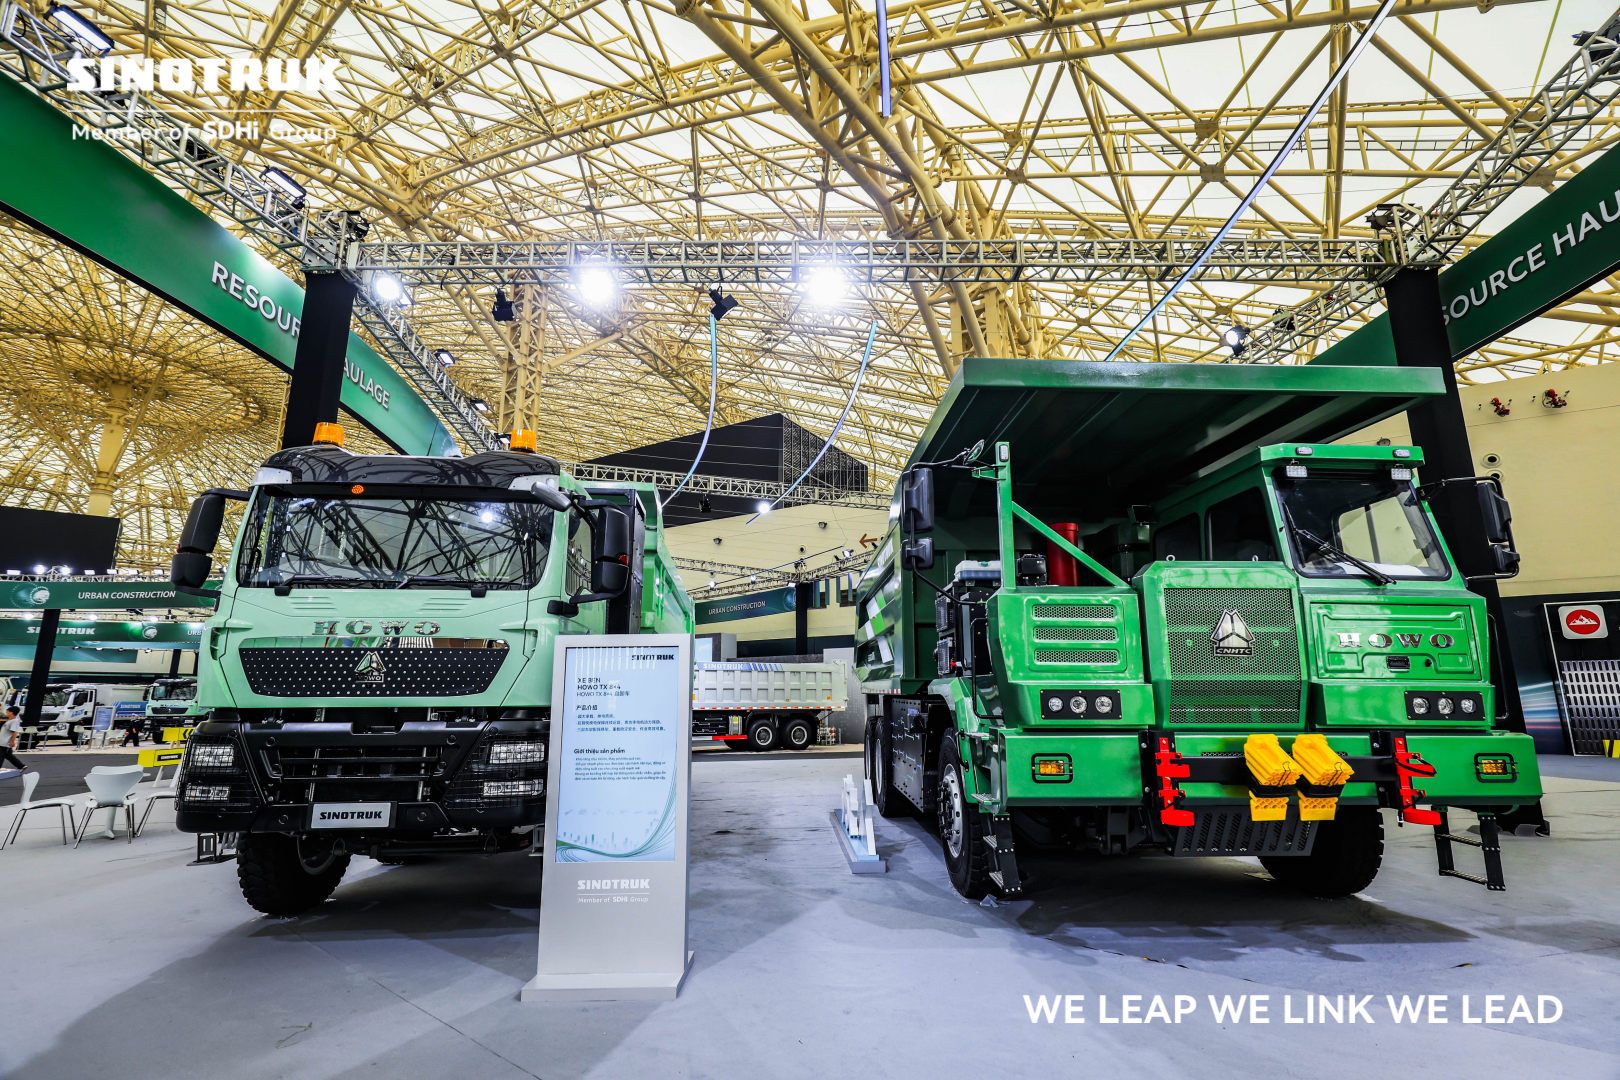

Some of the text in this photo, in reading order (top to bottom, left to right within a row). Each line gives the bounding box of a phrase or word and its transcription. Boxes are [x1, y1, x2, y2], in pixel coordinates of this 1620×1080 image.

[1442, 190, 1620, 326] OURCE HAU
[211, 260, 391, 409] RESOUR AULAGE
[111, 591, 176, 599] CONSTRUCTION
[708, 601, 766, 615] URBAN CONSTRUCTION
[26, 626, 96, 635] SITRUK
[311, 620, 441, 636] HOWO
[1337, 632, 1455, 649] HOWO
[319, 810, 383, 820] SINOTRUK
[577, 878, 650, 890] SINOTRUK
